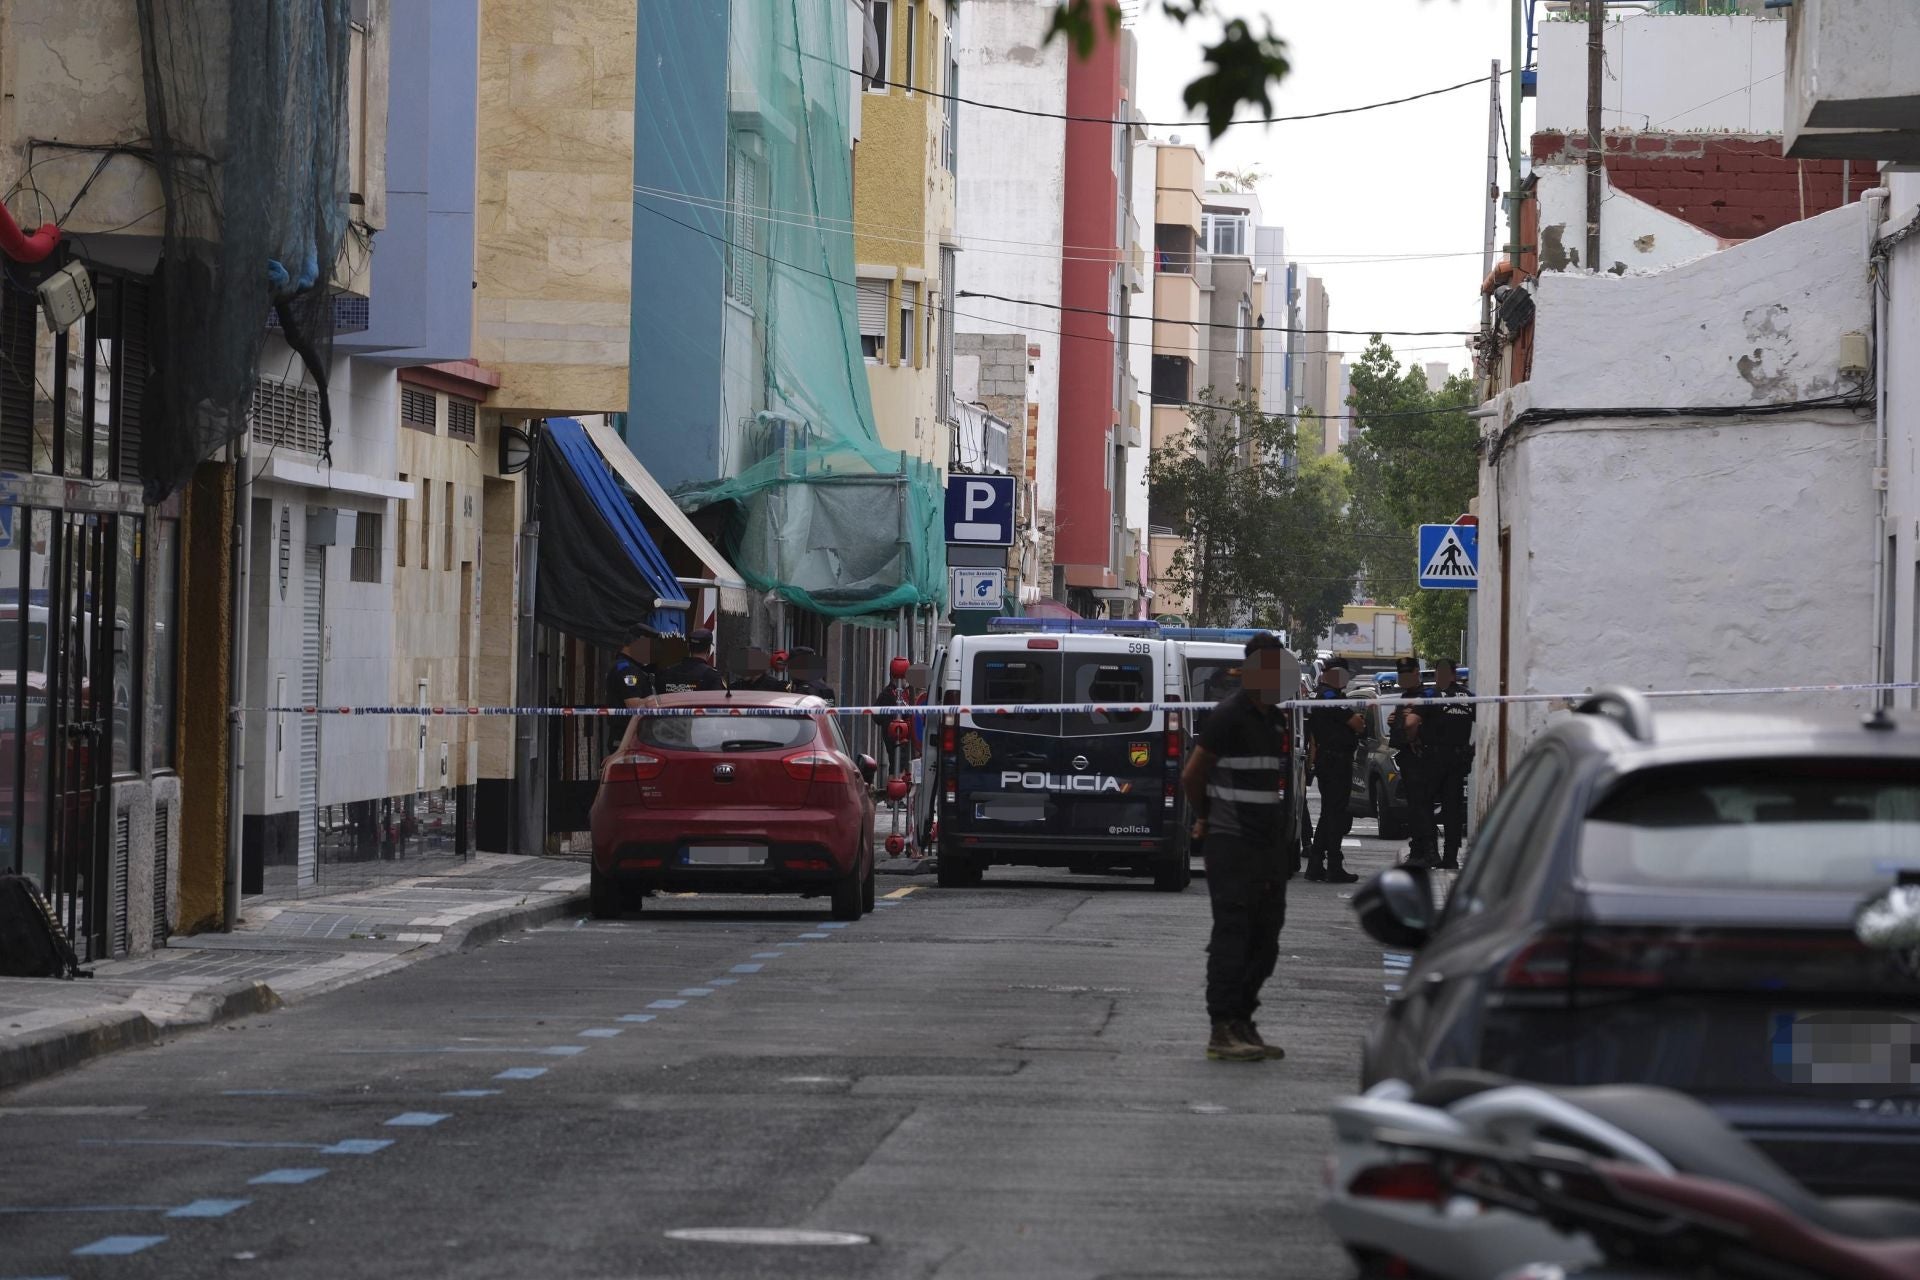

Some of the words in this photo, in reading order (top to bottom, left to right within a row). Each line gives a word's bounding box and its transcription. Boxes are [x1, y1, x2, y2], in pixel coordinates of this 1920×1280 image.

[965, 481, 996, 521] P
[1128, 643, 1151, 654] 59B
[716, 765, 733, 774] KIA
[1000, 770, 1121, 791] POLICÍA
[1108, 824, 1151, 834] @policia
